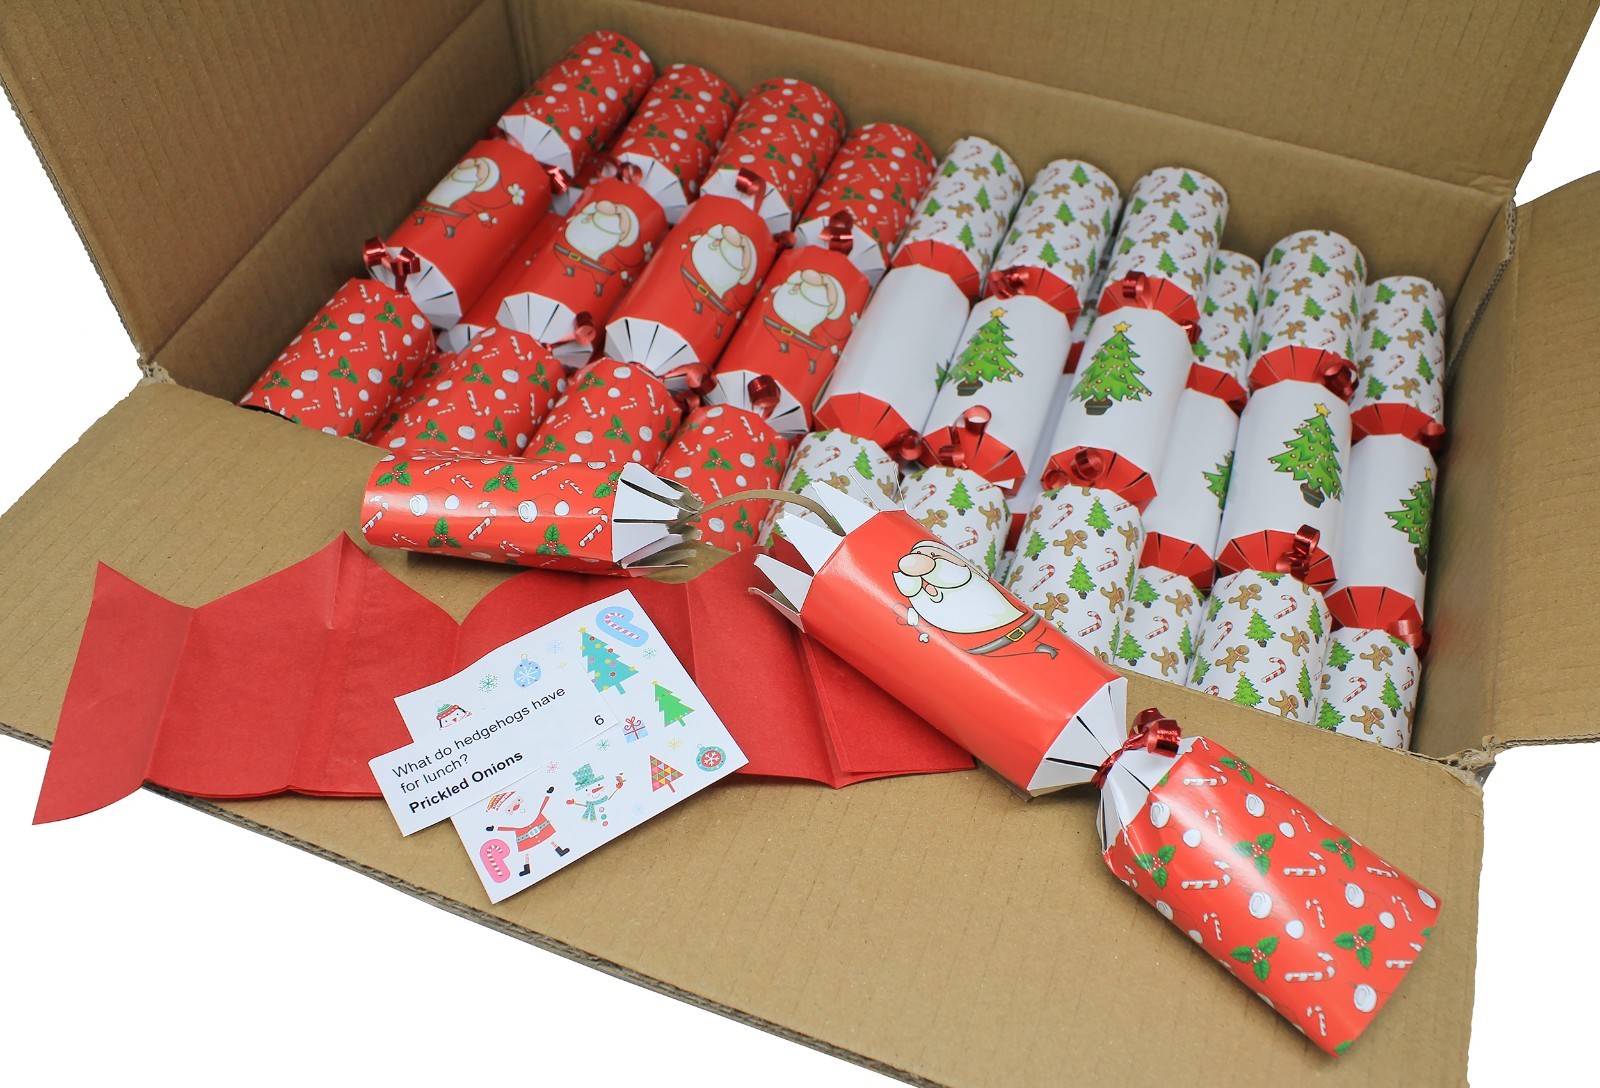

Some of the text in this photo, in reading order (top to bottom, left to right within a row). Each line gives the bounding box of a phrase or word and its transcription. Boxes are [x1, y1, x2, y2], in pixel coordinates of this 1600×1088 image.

[391, 687, 566, 778] What do hedgehogs have
[594, 714, 605, 726] 6
[400, 753, 469, 794] for lunch?
[408, 752, 523, 814] Prickled Onions
